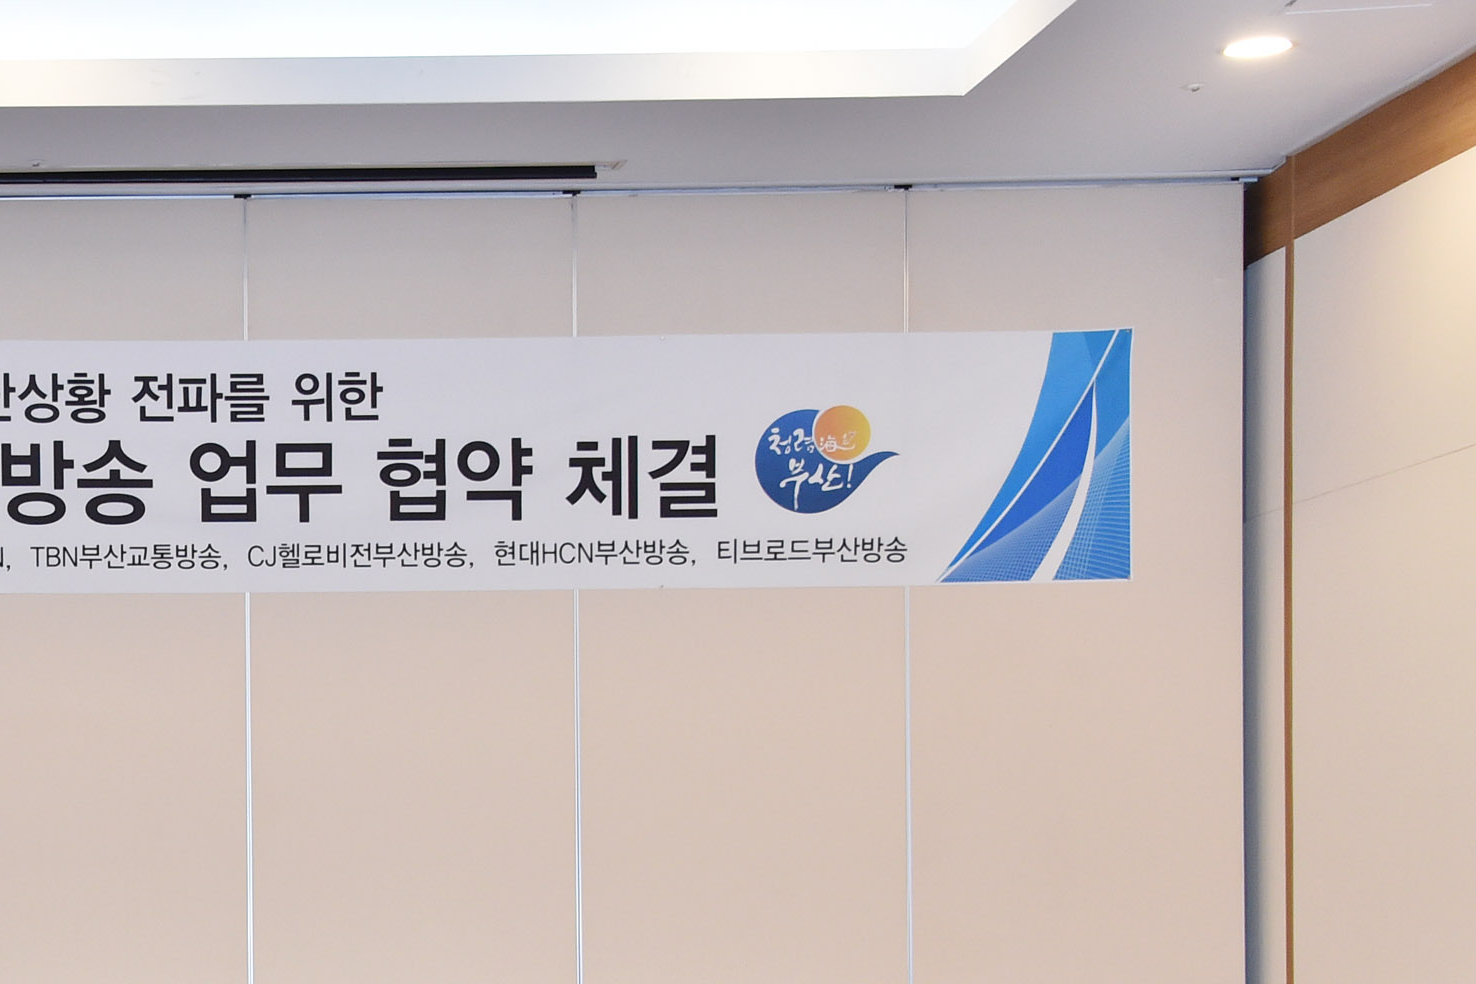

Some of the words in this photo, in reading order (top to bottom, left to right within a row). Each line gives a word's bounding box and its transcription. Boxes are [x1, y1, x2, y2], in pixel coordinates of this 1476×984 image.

[131, 372, 270, 423] 전파를
[291, 371, 384, 423] 위한
[189, 439, 343, 523] 업무
[376, 437, 534, 522] 협약
[565, 434, 718, 520] 체결
[779, 458, 854, 511] 부산!
[29, 543, 228, 571] TBN부산교통방송,
[247, 541, 474, 569] CJ헬로비전부산방송,
[493, 538, 696, 567] 현대HCN부산방송,
[717, 536, 908, 565] 티브로드부산방송
